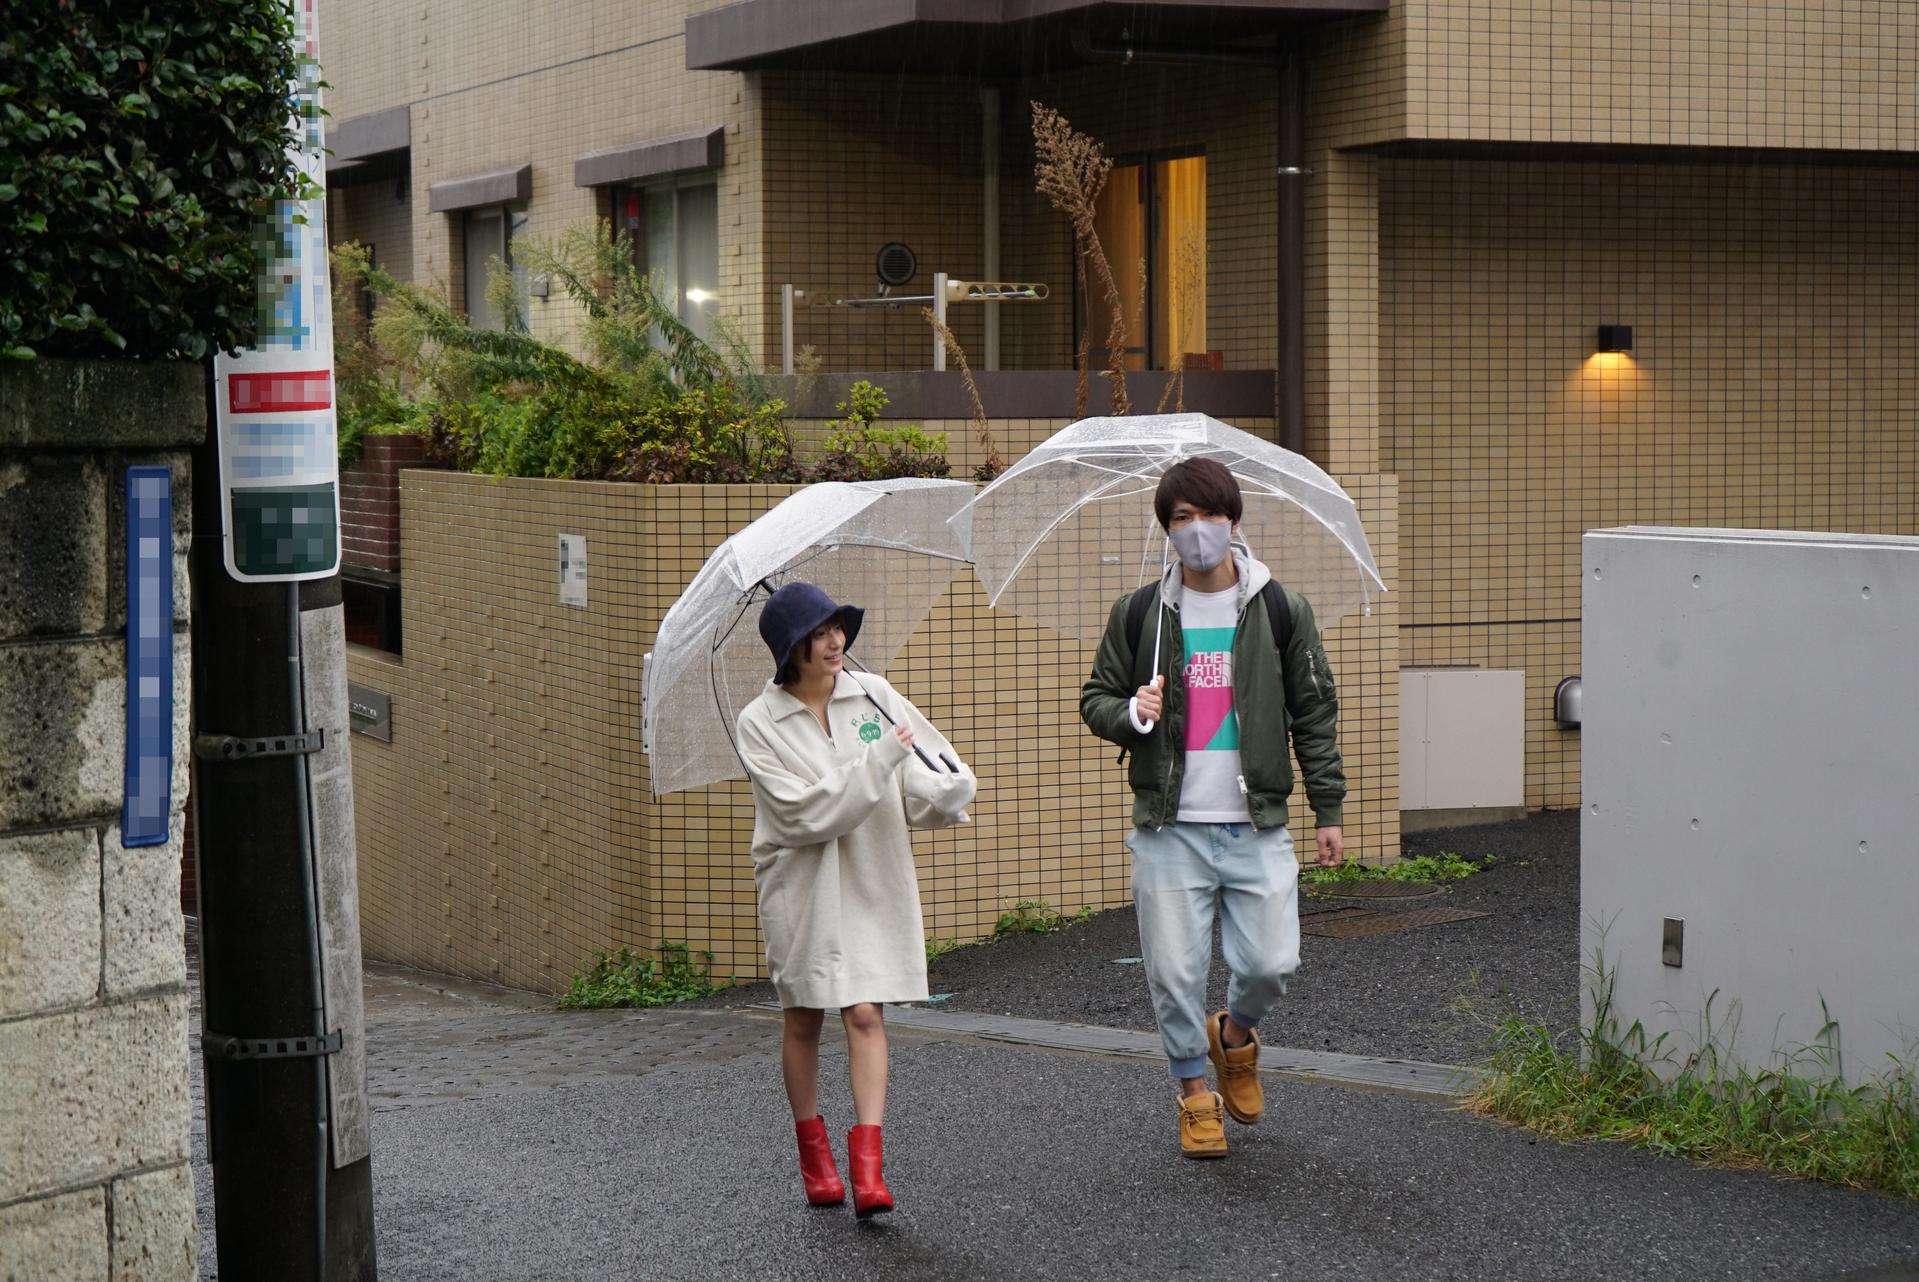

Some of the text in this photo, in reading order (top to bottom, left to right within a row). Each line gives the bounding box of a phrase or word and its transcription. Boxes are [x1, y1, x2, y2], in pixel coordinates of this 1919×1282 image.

[1195, 651, 1222, 664] THE
[1183, 663, 1222, 676] ORTH
[1188, 675, 1222, 688] FACE
